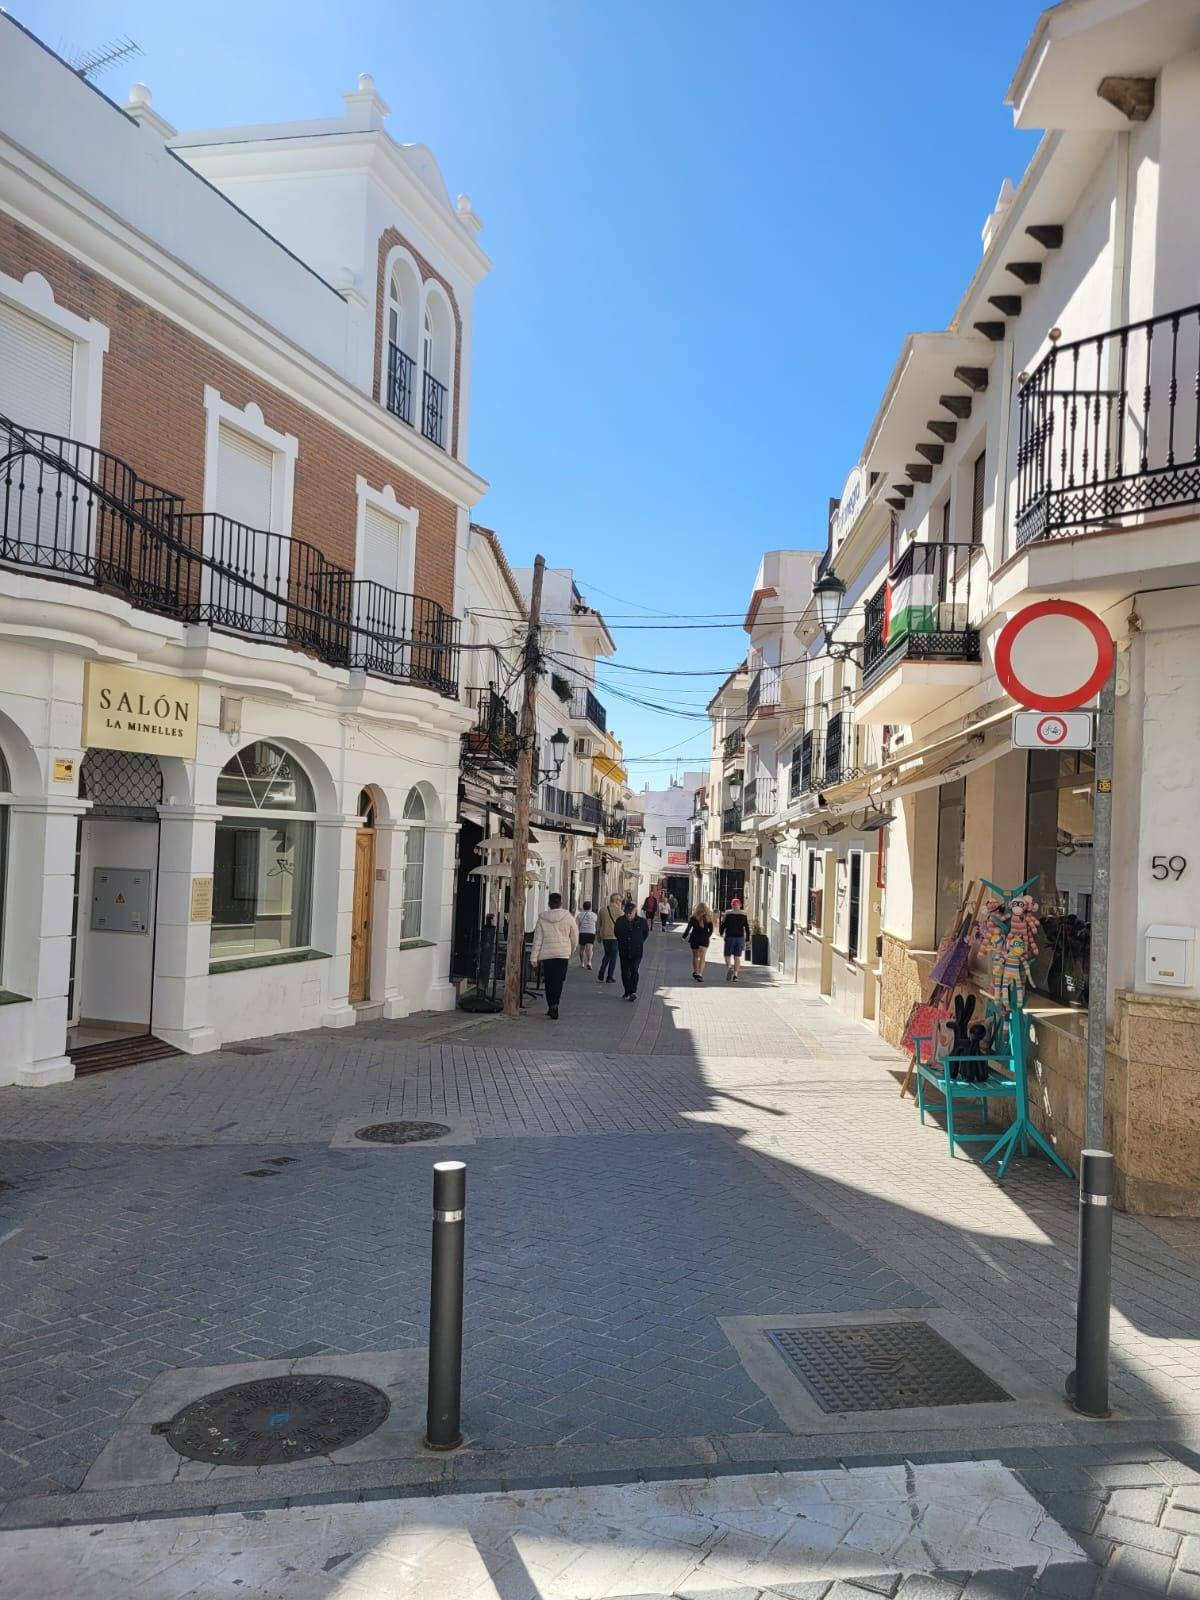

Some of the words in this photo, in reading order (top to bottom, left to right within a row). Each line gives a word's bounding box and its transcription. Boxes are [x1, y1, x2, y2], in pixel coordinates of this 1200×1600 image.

[100, 688, 189, 722] SALÓN
[106, 718, 122, 729] LA
[128, 721, 184, 738] MINELLES
[1152, 855, 1187, 881] 59
